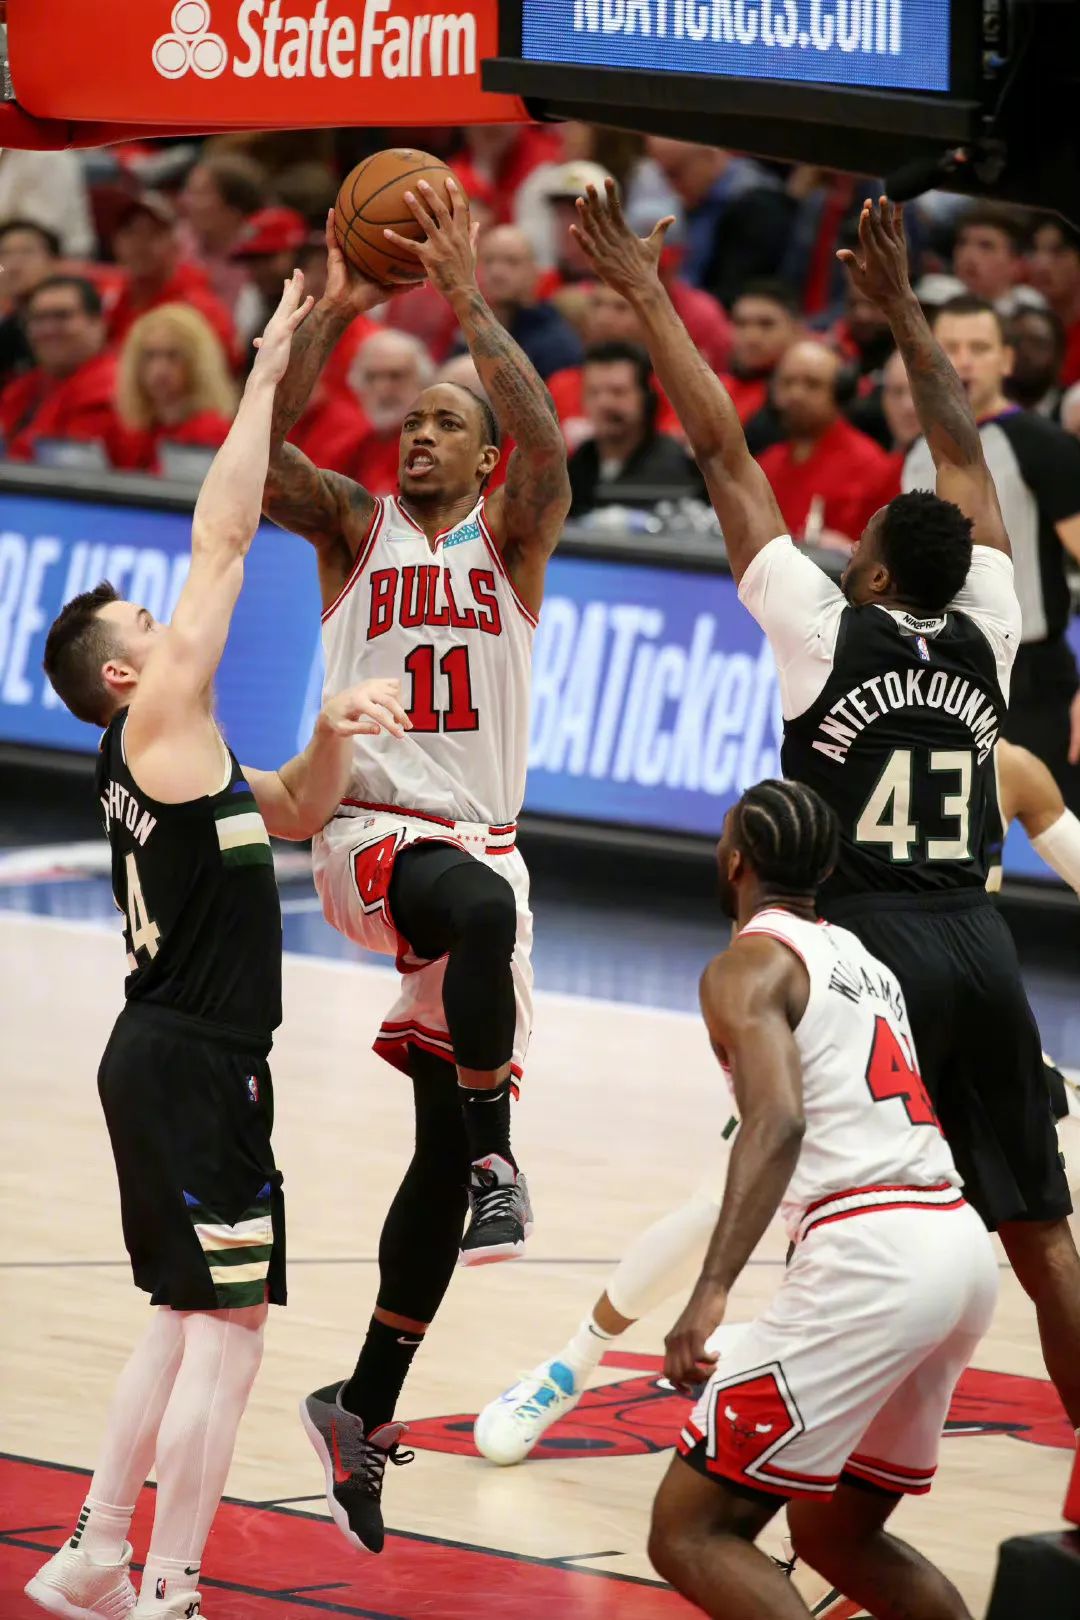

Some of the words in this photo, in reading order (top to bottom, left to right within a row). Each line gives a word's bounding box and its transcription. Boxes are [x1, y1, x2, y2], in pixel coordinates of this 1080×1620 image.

[367, 565, 502, 641] BULLS
[404, 644, 479, 733] 11
[99, 780, 158, 847] HTON
[855, 749, 975, 861] 43
[122, 852, 162, 970] 4
[865, 1014, 944, 1137] 4
